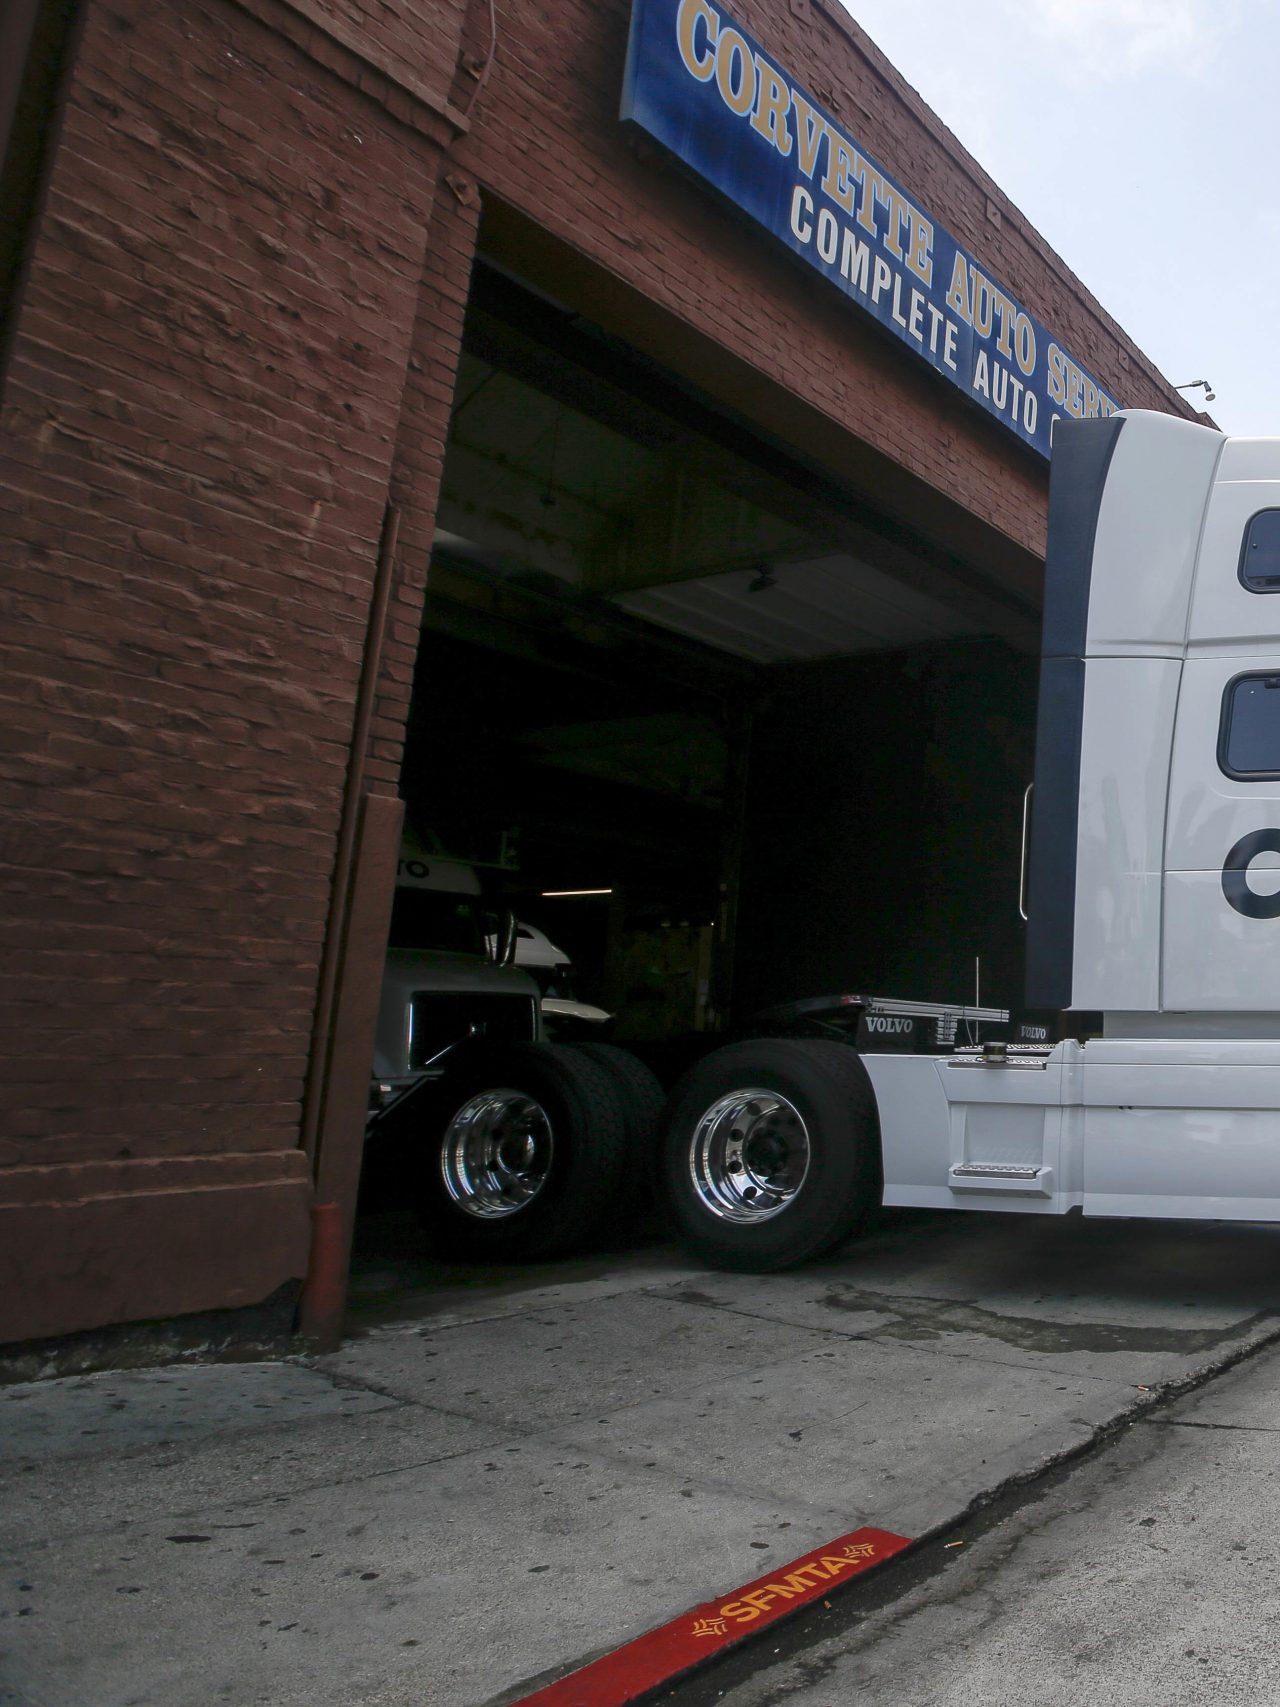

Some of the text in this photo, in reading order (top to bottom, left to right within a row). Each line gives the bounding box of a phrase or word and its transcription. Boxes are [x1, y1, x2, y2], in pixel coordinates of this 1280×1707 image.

[677, 0, 934, 288] CORVETTE
[946, 250, 1036, 377] AUTO
[790, 185, 1038, 434] COMPLETE AUTO
[865, 1016, 913, 1033] VOLVO
[1020, 1025, 1046, 1039] VOLVO
[720, 1555, 861, 1623] SFMTA
